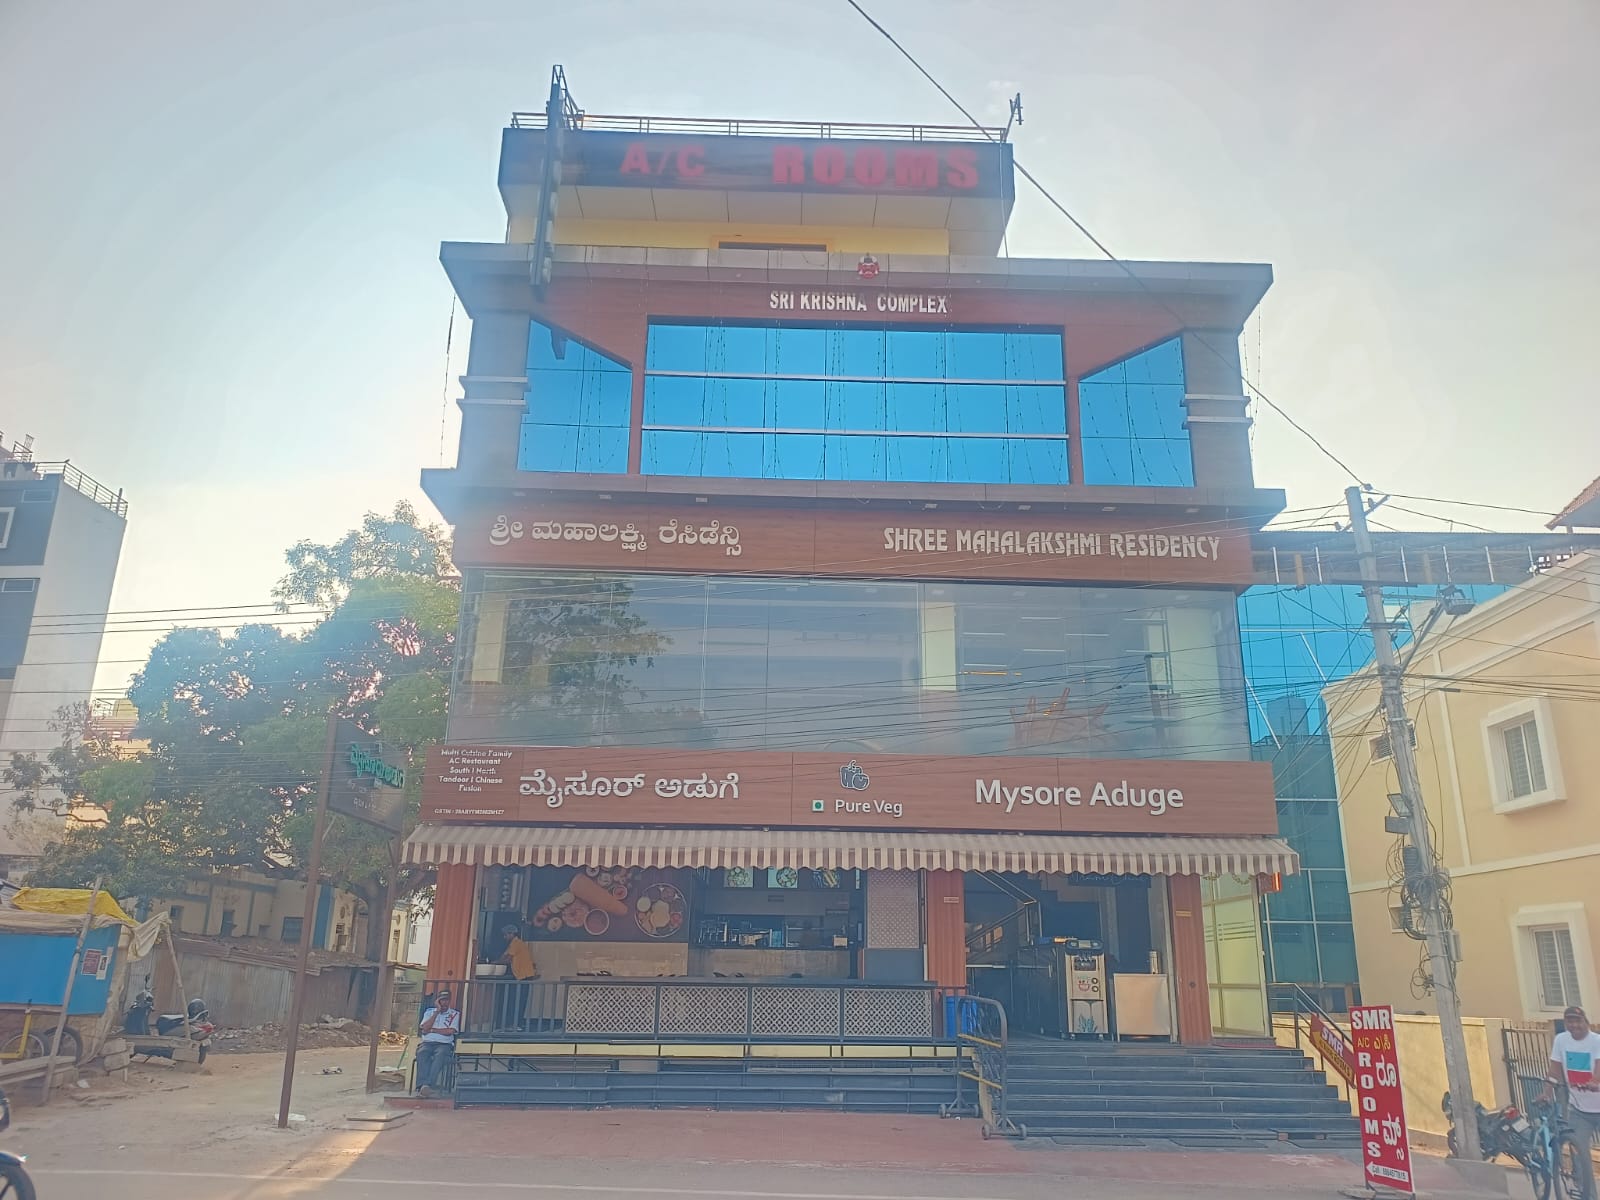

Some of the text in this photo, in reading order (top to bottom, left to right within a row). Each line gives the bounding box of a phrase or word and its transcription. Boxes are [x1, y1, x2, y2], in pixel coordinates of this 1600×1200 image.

[620, 142, 980, 189] A/C ROOMS
[769, 291, 948, 314] SRI KRISHNA COMPLEX
[489, 514, 524, 545] ಶ್ರೀ
[883, 527, 1221, 561] SHREE MAHALAKSHMI RESIDENCY
[461, 757, 501, 765] Restaurant
[488, 750, 513, 758] Family
[459, 784, 482, 792] Fusion
[475, 776, 503, 784] Chinese
[519, 768, 740, 808] ಮೈಸೂರ್ ಅಡುಗೆ
[834, 799, 903, 817] Pure Veg
[974, 779, 1184, 816] Mysore Aduge
[1351, 1009, 1392, 1030] SMR
[1322, 1026, 1344, 1057] SMR
